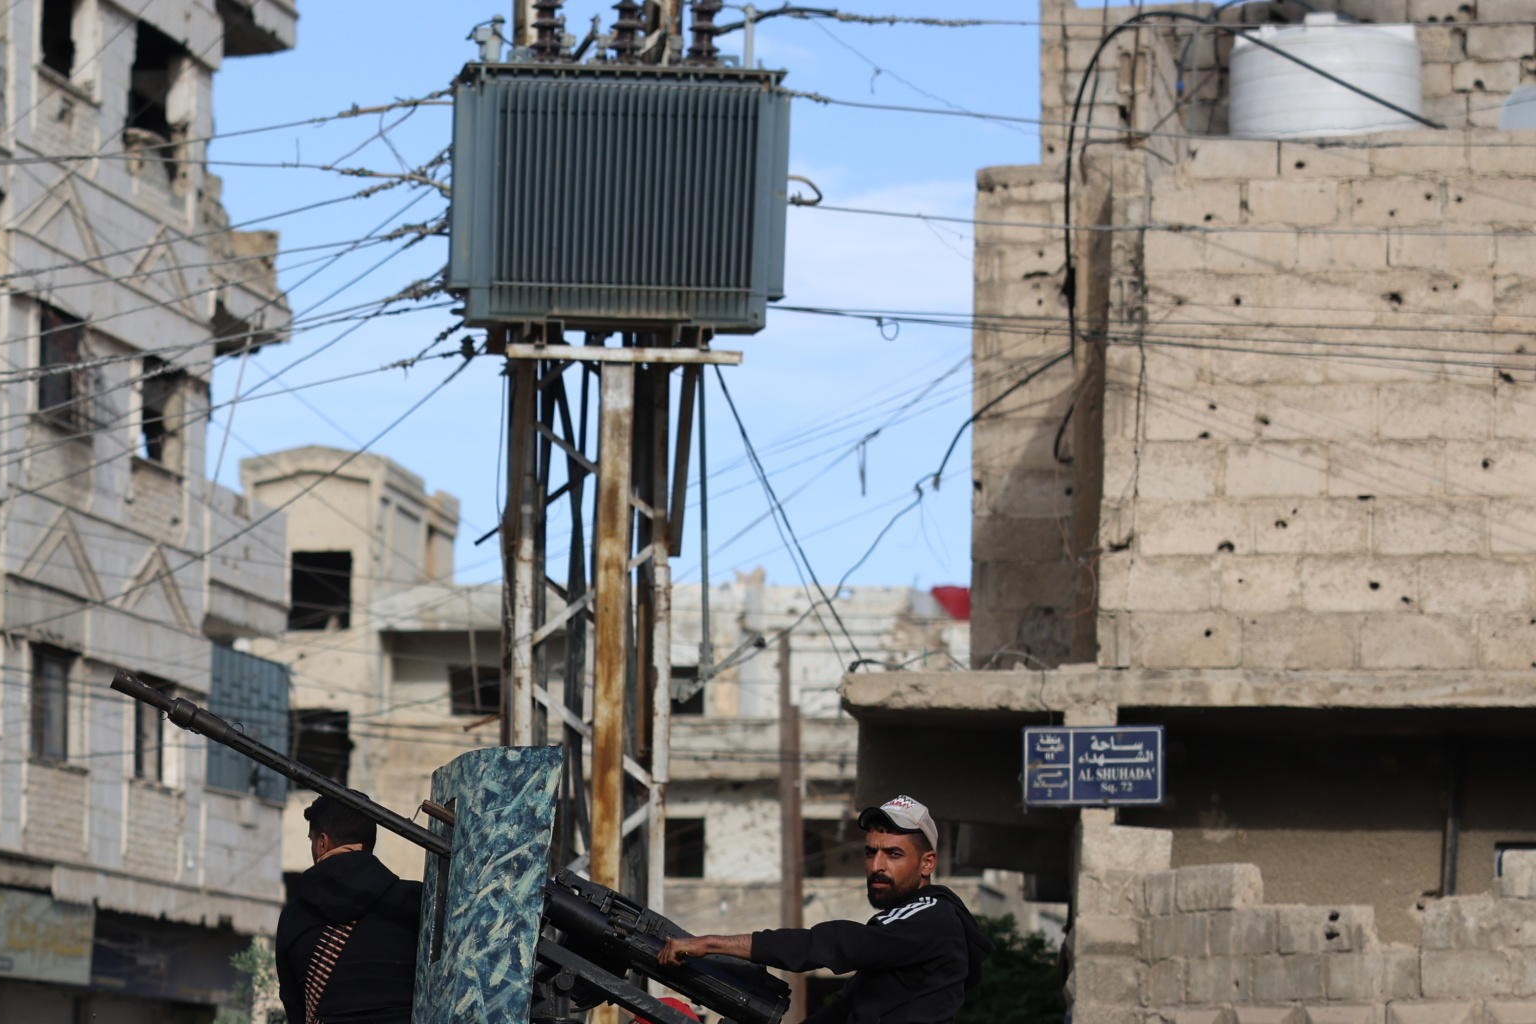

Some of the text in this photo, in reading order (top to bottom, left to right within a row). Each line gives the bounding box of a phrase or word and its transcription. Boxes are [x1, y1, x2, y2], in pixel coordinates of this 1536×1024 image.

[1090, 735, 1143, 751] ساحة
[1078, 749, 1154, 767] الشهداء
[1079, 770, 1094, 782] AL
[1096, 768, 1155, 781] SHUHADA'
[1100, 781, 1133, 794] Sq. 72
